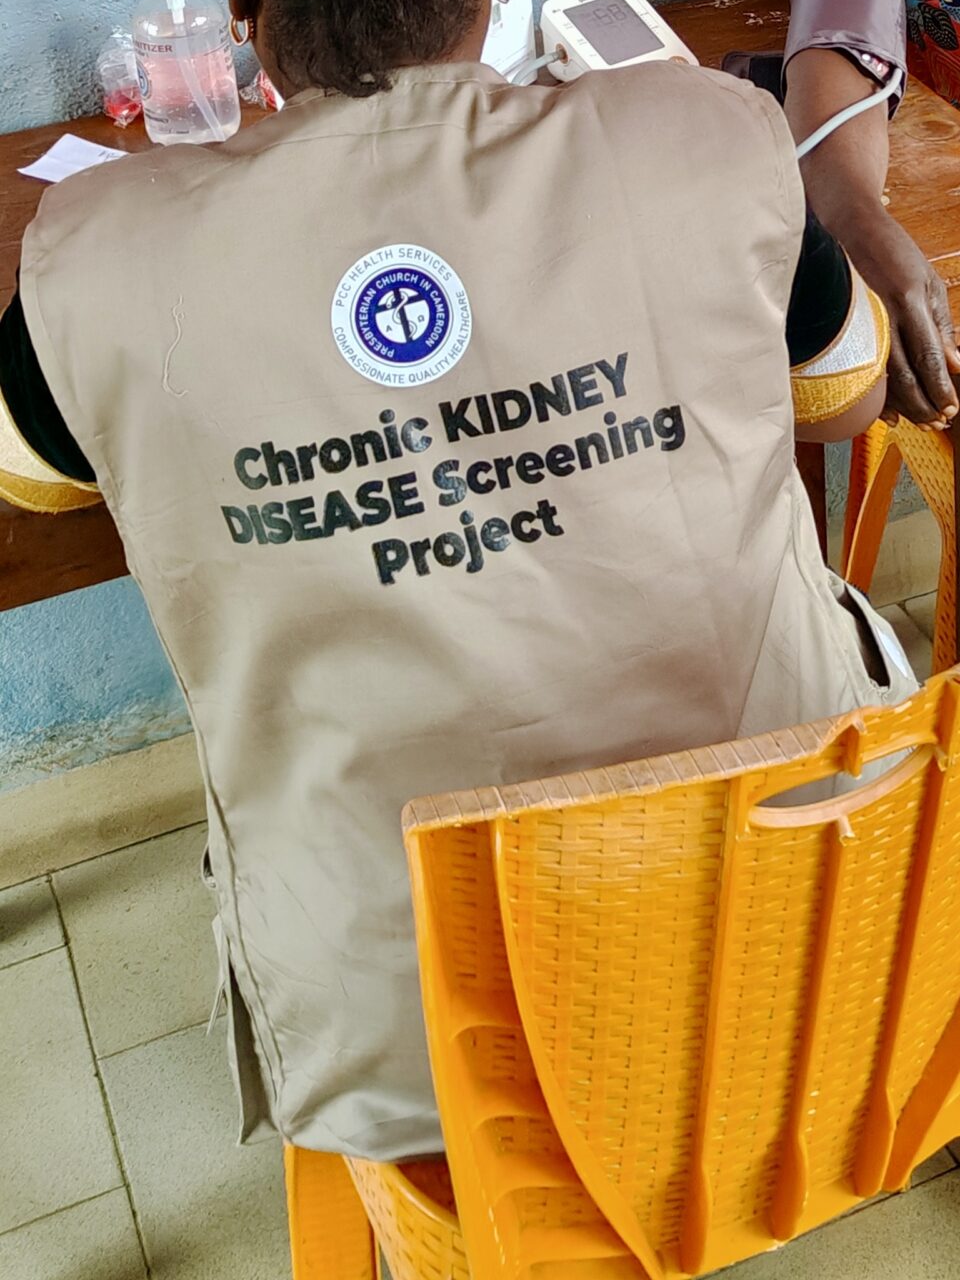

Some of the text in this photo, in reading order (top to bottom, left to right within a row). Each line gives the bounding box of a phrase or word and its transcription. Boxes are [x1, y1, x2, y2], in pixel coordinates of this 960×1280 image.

[336, 248, 452, 307] PCC HEALTH SERVICES
[359, 272, 445, 358] PRESBYTERIAN CHURCH IN CAMEROON
[334, 290, 470, 384] COMPASSIONATE QUALITY HEALTHCARE
[233, 353, 629, 490] Chronic KIDNEY
[220, 405, 686, 545] DISEASE Screening
